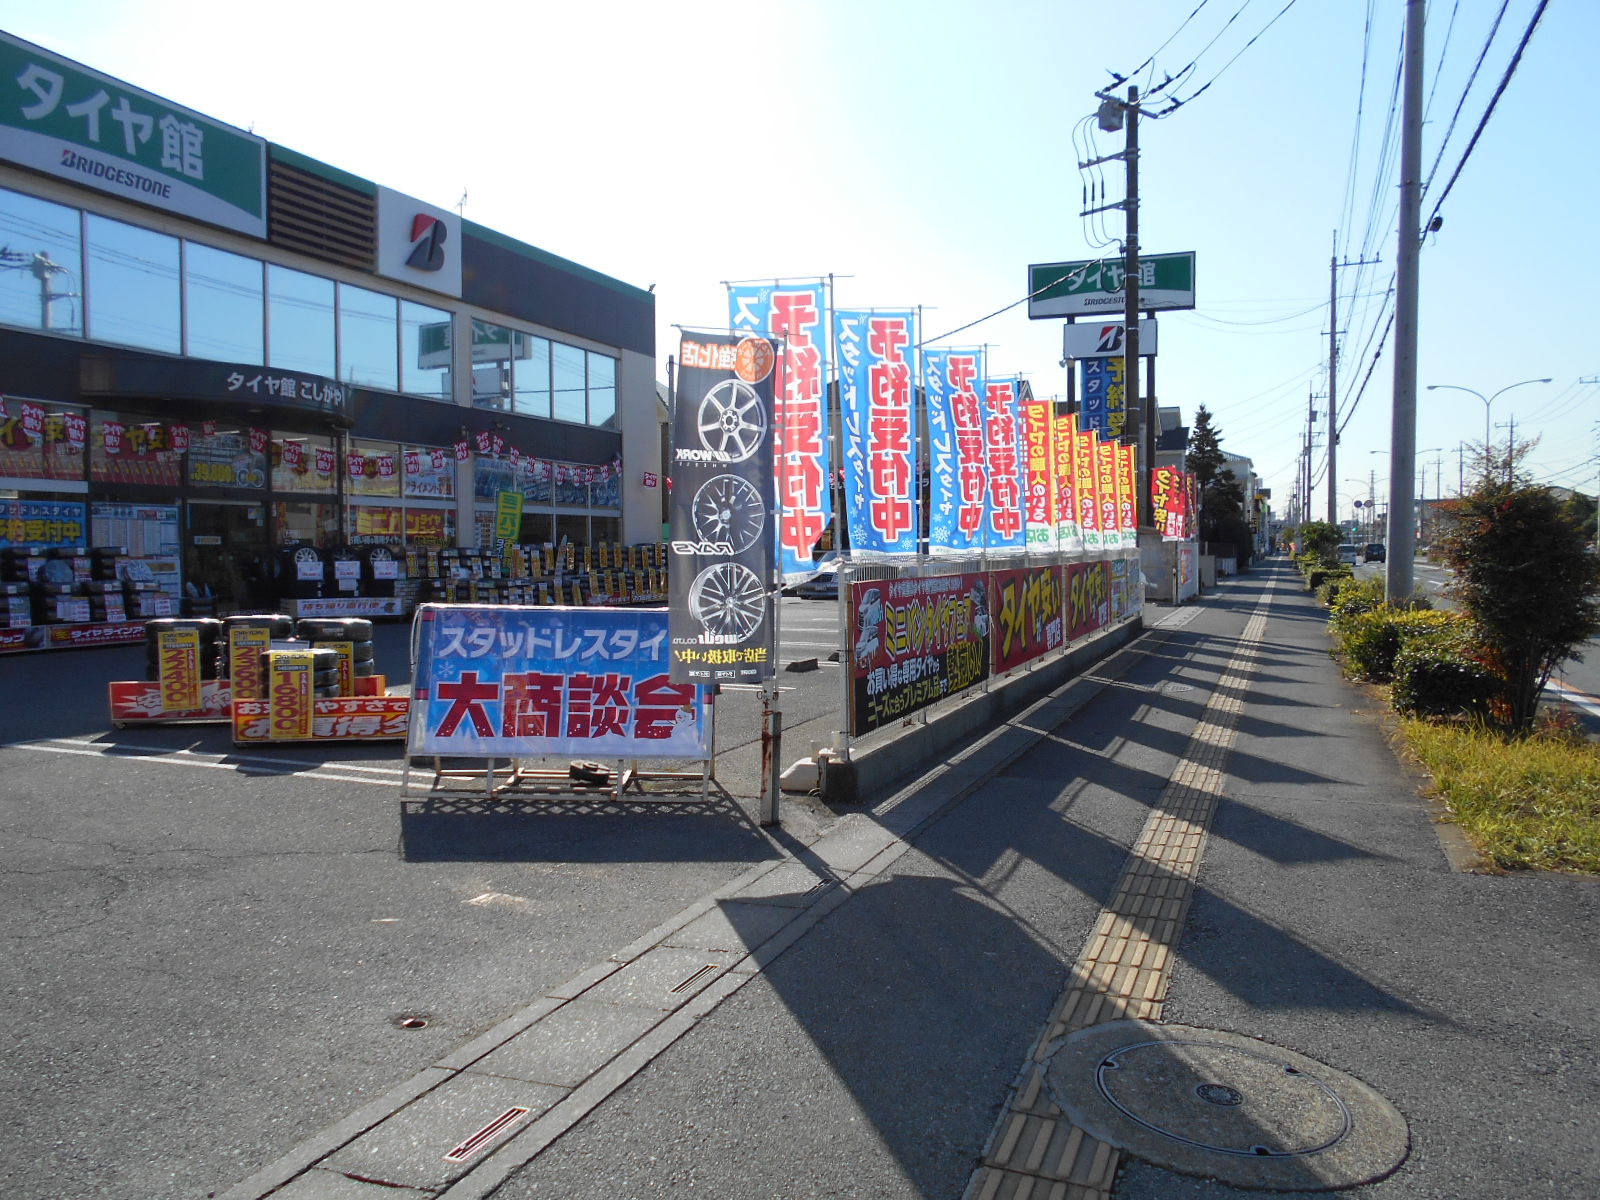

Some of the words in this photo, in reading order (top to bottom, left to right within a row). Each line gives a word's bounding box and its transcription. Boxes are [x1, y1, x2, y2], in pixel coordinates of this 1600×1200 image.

[16, 63, 204, 180] タイヤ館
[60, 149, 171, 199] BRIDGESTONE
[227, 372, 296, 399] タイヤ館
[439, 627, 669, 661] スタッドレスタイ
[238, 701, 407, 715] おやすさで
[434, 671, 696, 739] 大商談会
